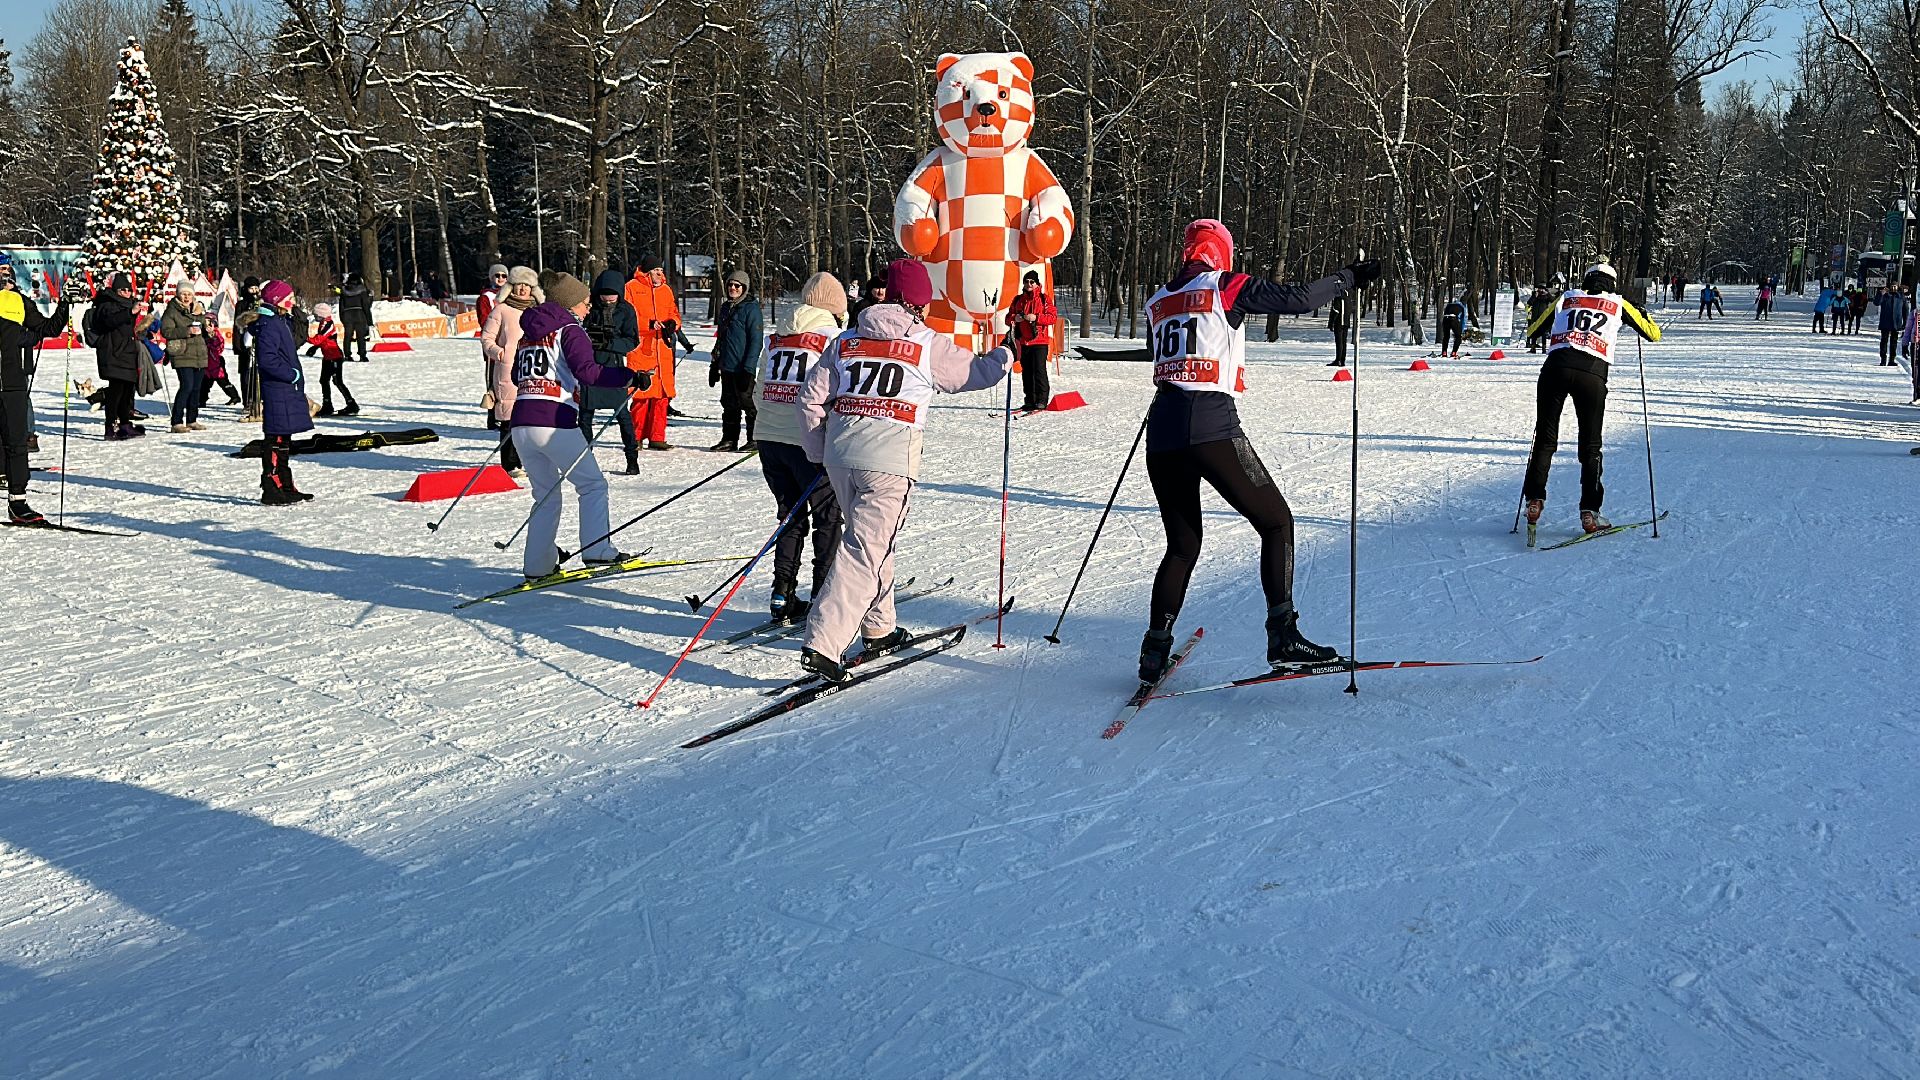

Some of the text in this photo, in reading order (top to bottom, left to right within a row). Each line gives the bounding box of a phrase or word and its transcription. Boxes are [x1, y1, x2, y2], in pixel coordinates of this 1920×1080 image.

[389, 320, 436, 331] CHOCOLATE
[1567, 309, 1608, 336] 162
[1155, 317, 1198, 361] 161
[519, 349, 549, 379] 159
[771, 351, 808, 382] 171
[1164, 361, 1189, 373] ВФСК
[1192, 361, 1213, 370] ГТО
[777, 384, 801, 394] ВФСК
[846, 361, 904, 397] 170
[839, 404, 895, 418] ОДИНЦОВО
[858, 399, 889, 409] ВФСК
[890, 401, 912, 412] ГТО
